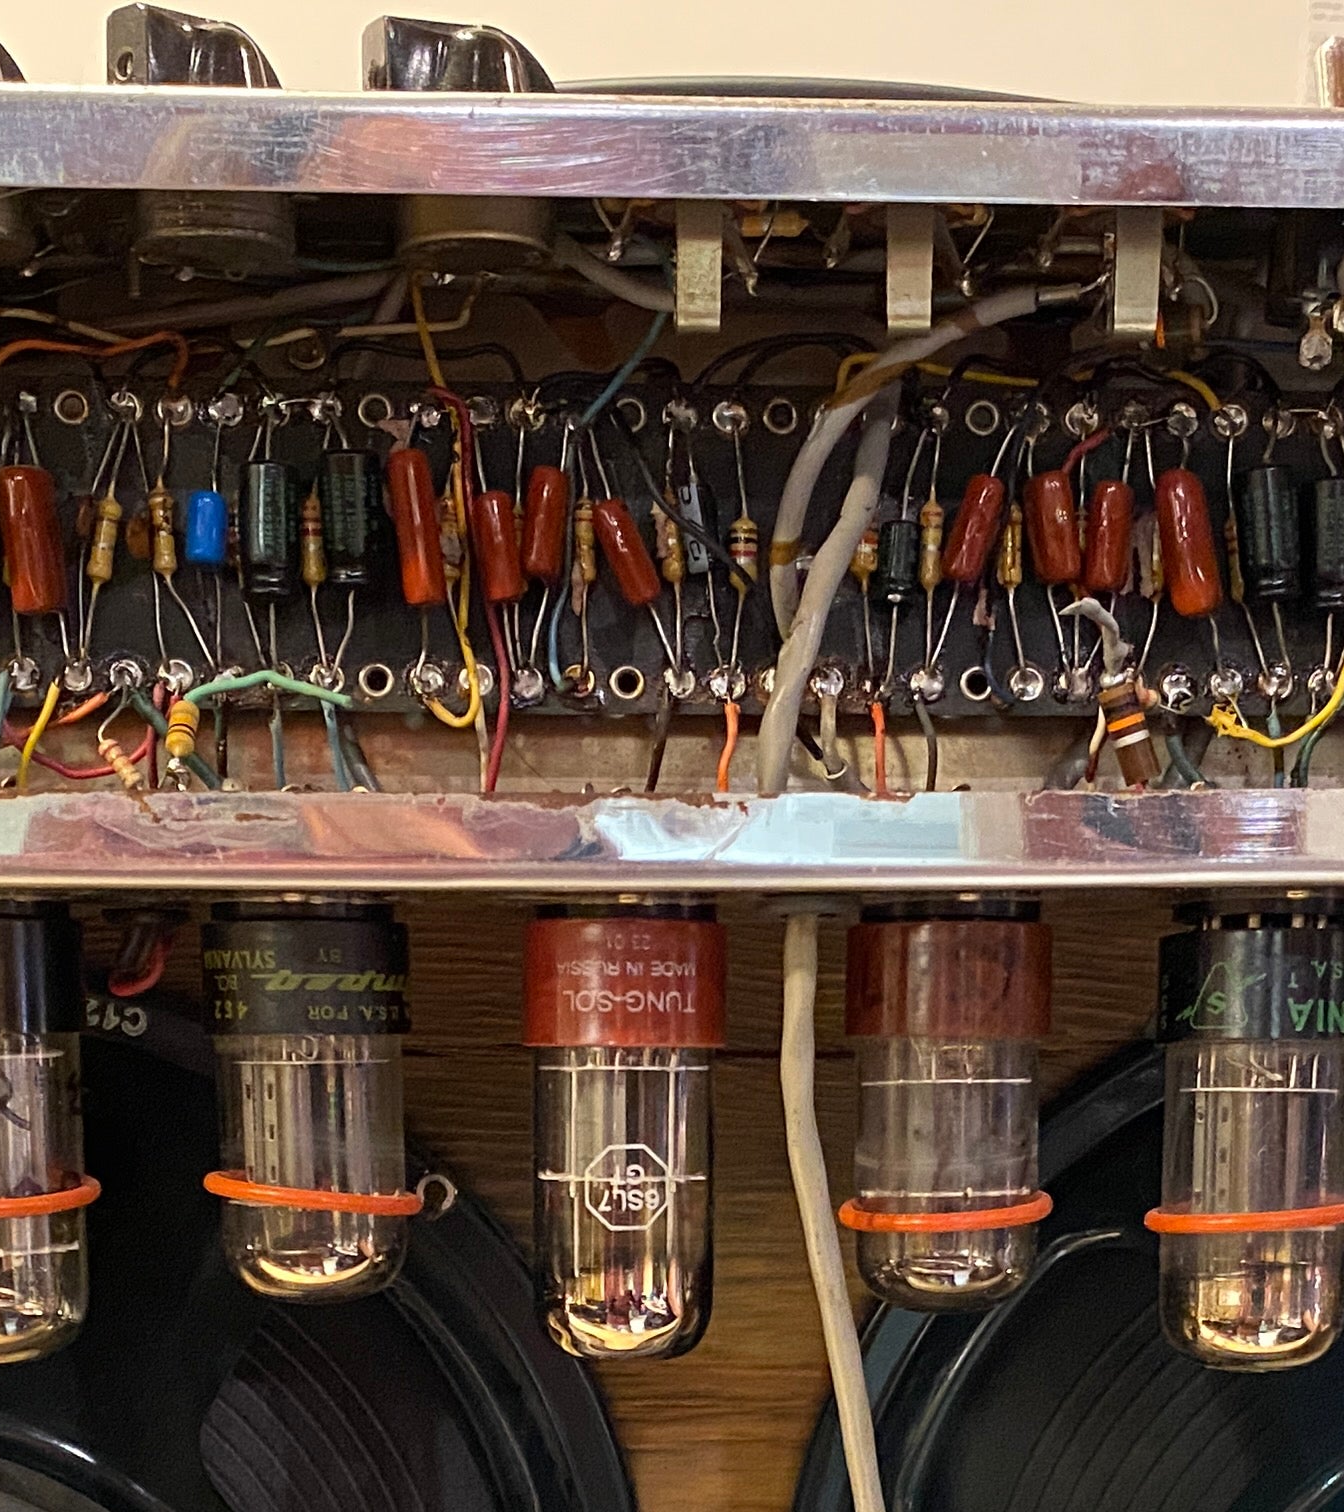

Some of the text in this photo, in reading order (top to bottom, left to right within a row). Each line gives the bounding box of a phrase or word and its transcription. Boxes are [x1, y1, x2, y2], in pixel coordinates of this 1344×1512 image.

[556, 960, 696, 976] MADE IN RUSSIA
[250, 969, 405, 991] mpeg
[563, 990, 696, 1013] TUNG-SOL
[308, 1006, 348, 1020] FOR
[610, 1164, 645, 1185] GT
[597, 1189, 660, 1212] 6SL7
